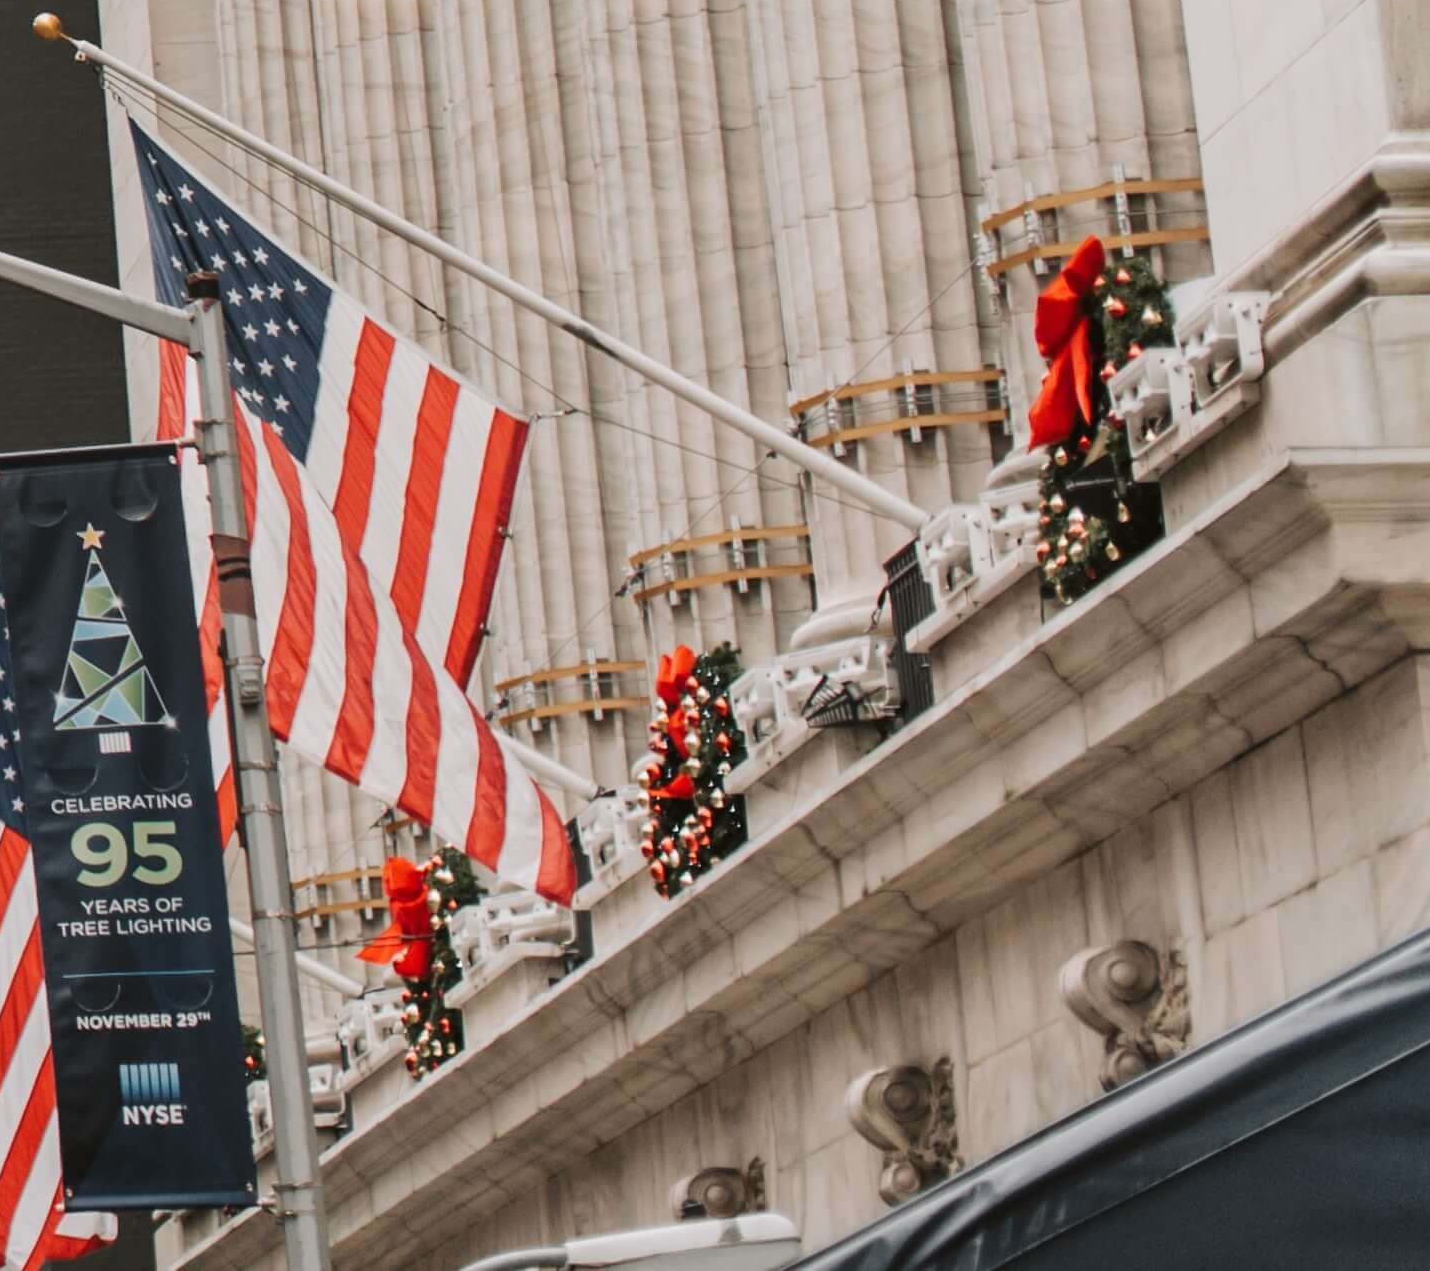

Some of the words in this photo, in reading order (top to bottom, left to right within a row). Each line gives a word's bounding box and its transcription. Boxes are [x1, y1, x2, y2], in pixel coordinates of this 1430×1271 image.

[51, 793, 193, 814] CELEBRATING
[71, 820, 183, 888] 95
[81, 898, 150, 915] YEARS
[155, 897, 183, 913] OF
[57, 920, 110, 937] TREE
[116, 917, 212, 936] LIGHTING
[76, 1013, 172, 1030] NOVEMBER
[176, 1012, 211, 1028] 29TH
[122, 1104, 184, 1126] NYSE
